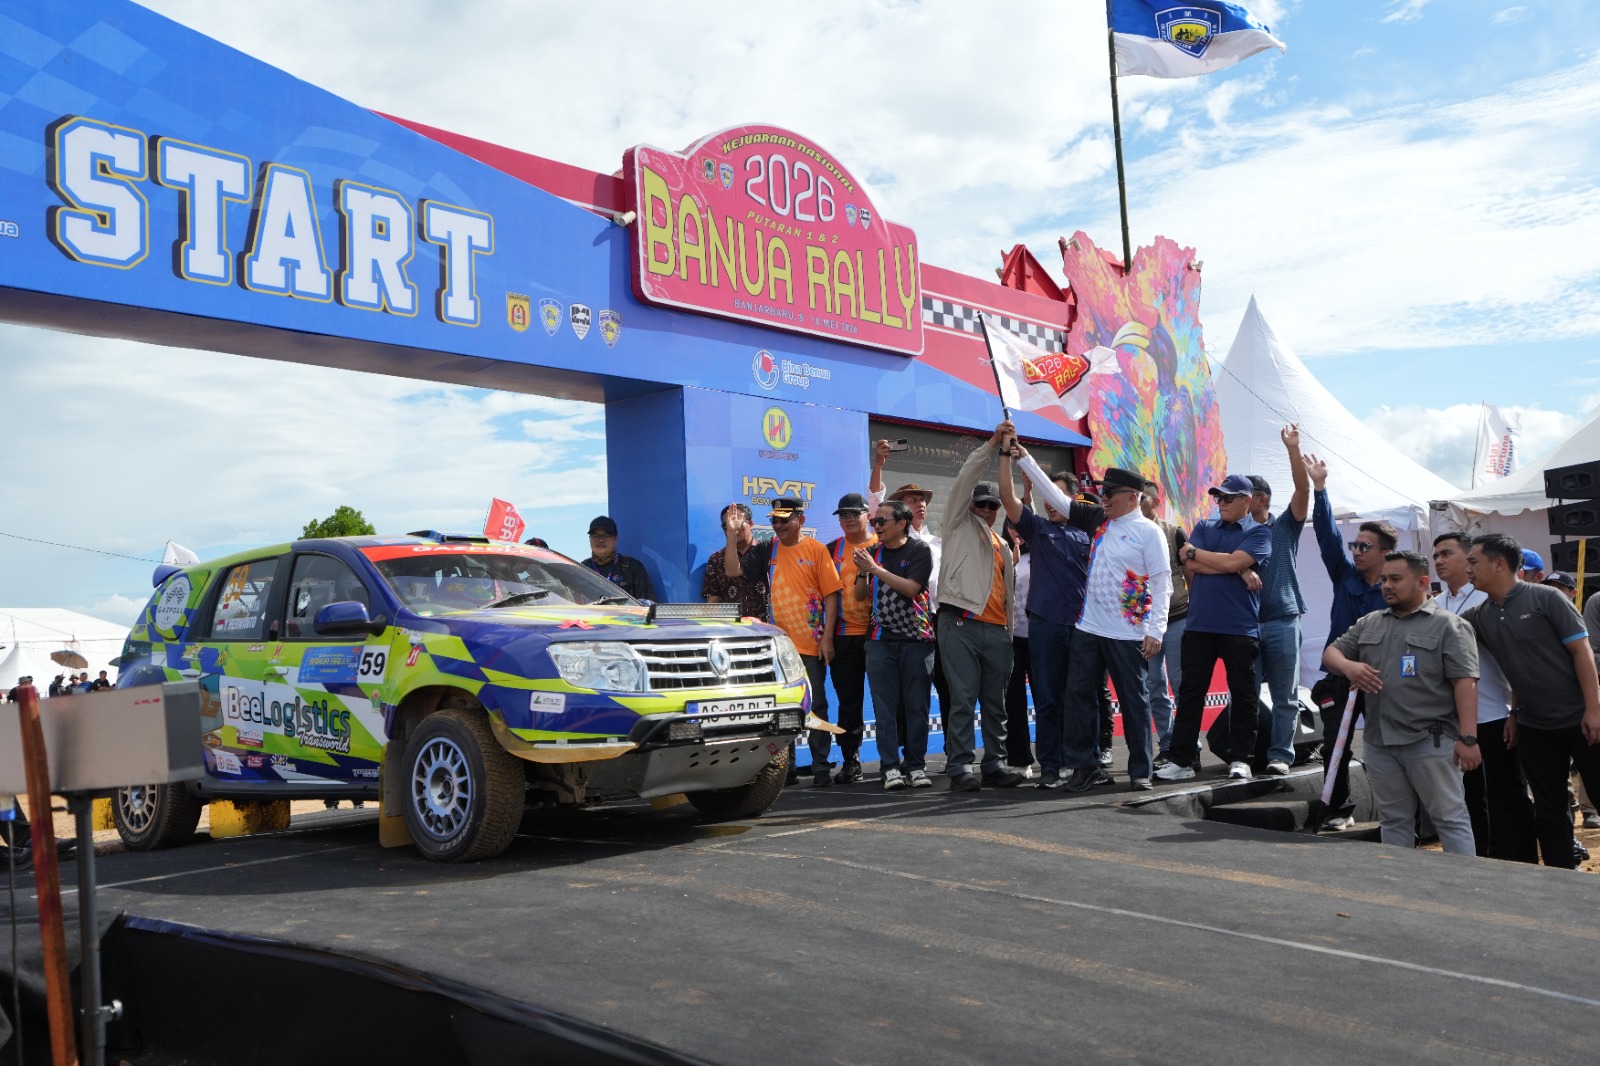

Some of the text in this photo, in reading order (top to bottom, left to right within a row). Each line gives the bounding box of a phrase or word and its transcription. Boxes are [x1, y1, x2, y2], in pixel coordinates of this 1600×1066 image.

[722, 133, 855, 195] KEJUARAAN NASIONAL
[743, 153, 835, 222] 2026
[46, 114, 495, 328] START
[746, 210, 838, 243] PUTARAN 1 & 2
[642, 164, 918, 331] BANUA RALLY
[823, 319, 838, 330] MEI
[841, 322, 858, 334] 2026
[782, 359, 831, 380] Bina Benua
[782, 372, 810, 390] Group
[1485, 443, 1499, 474] Lintas
[225, 563, 249, 603] 59
[360, 652, 386, 676] 59
[228, 685, 351, 738] BeeLogistics
[299, 726, 350, 754] Transworld
